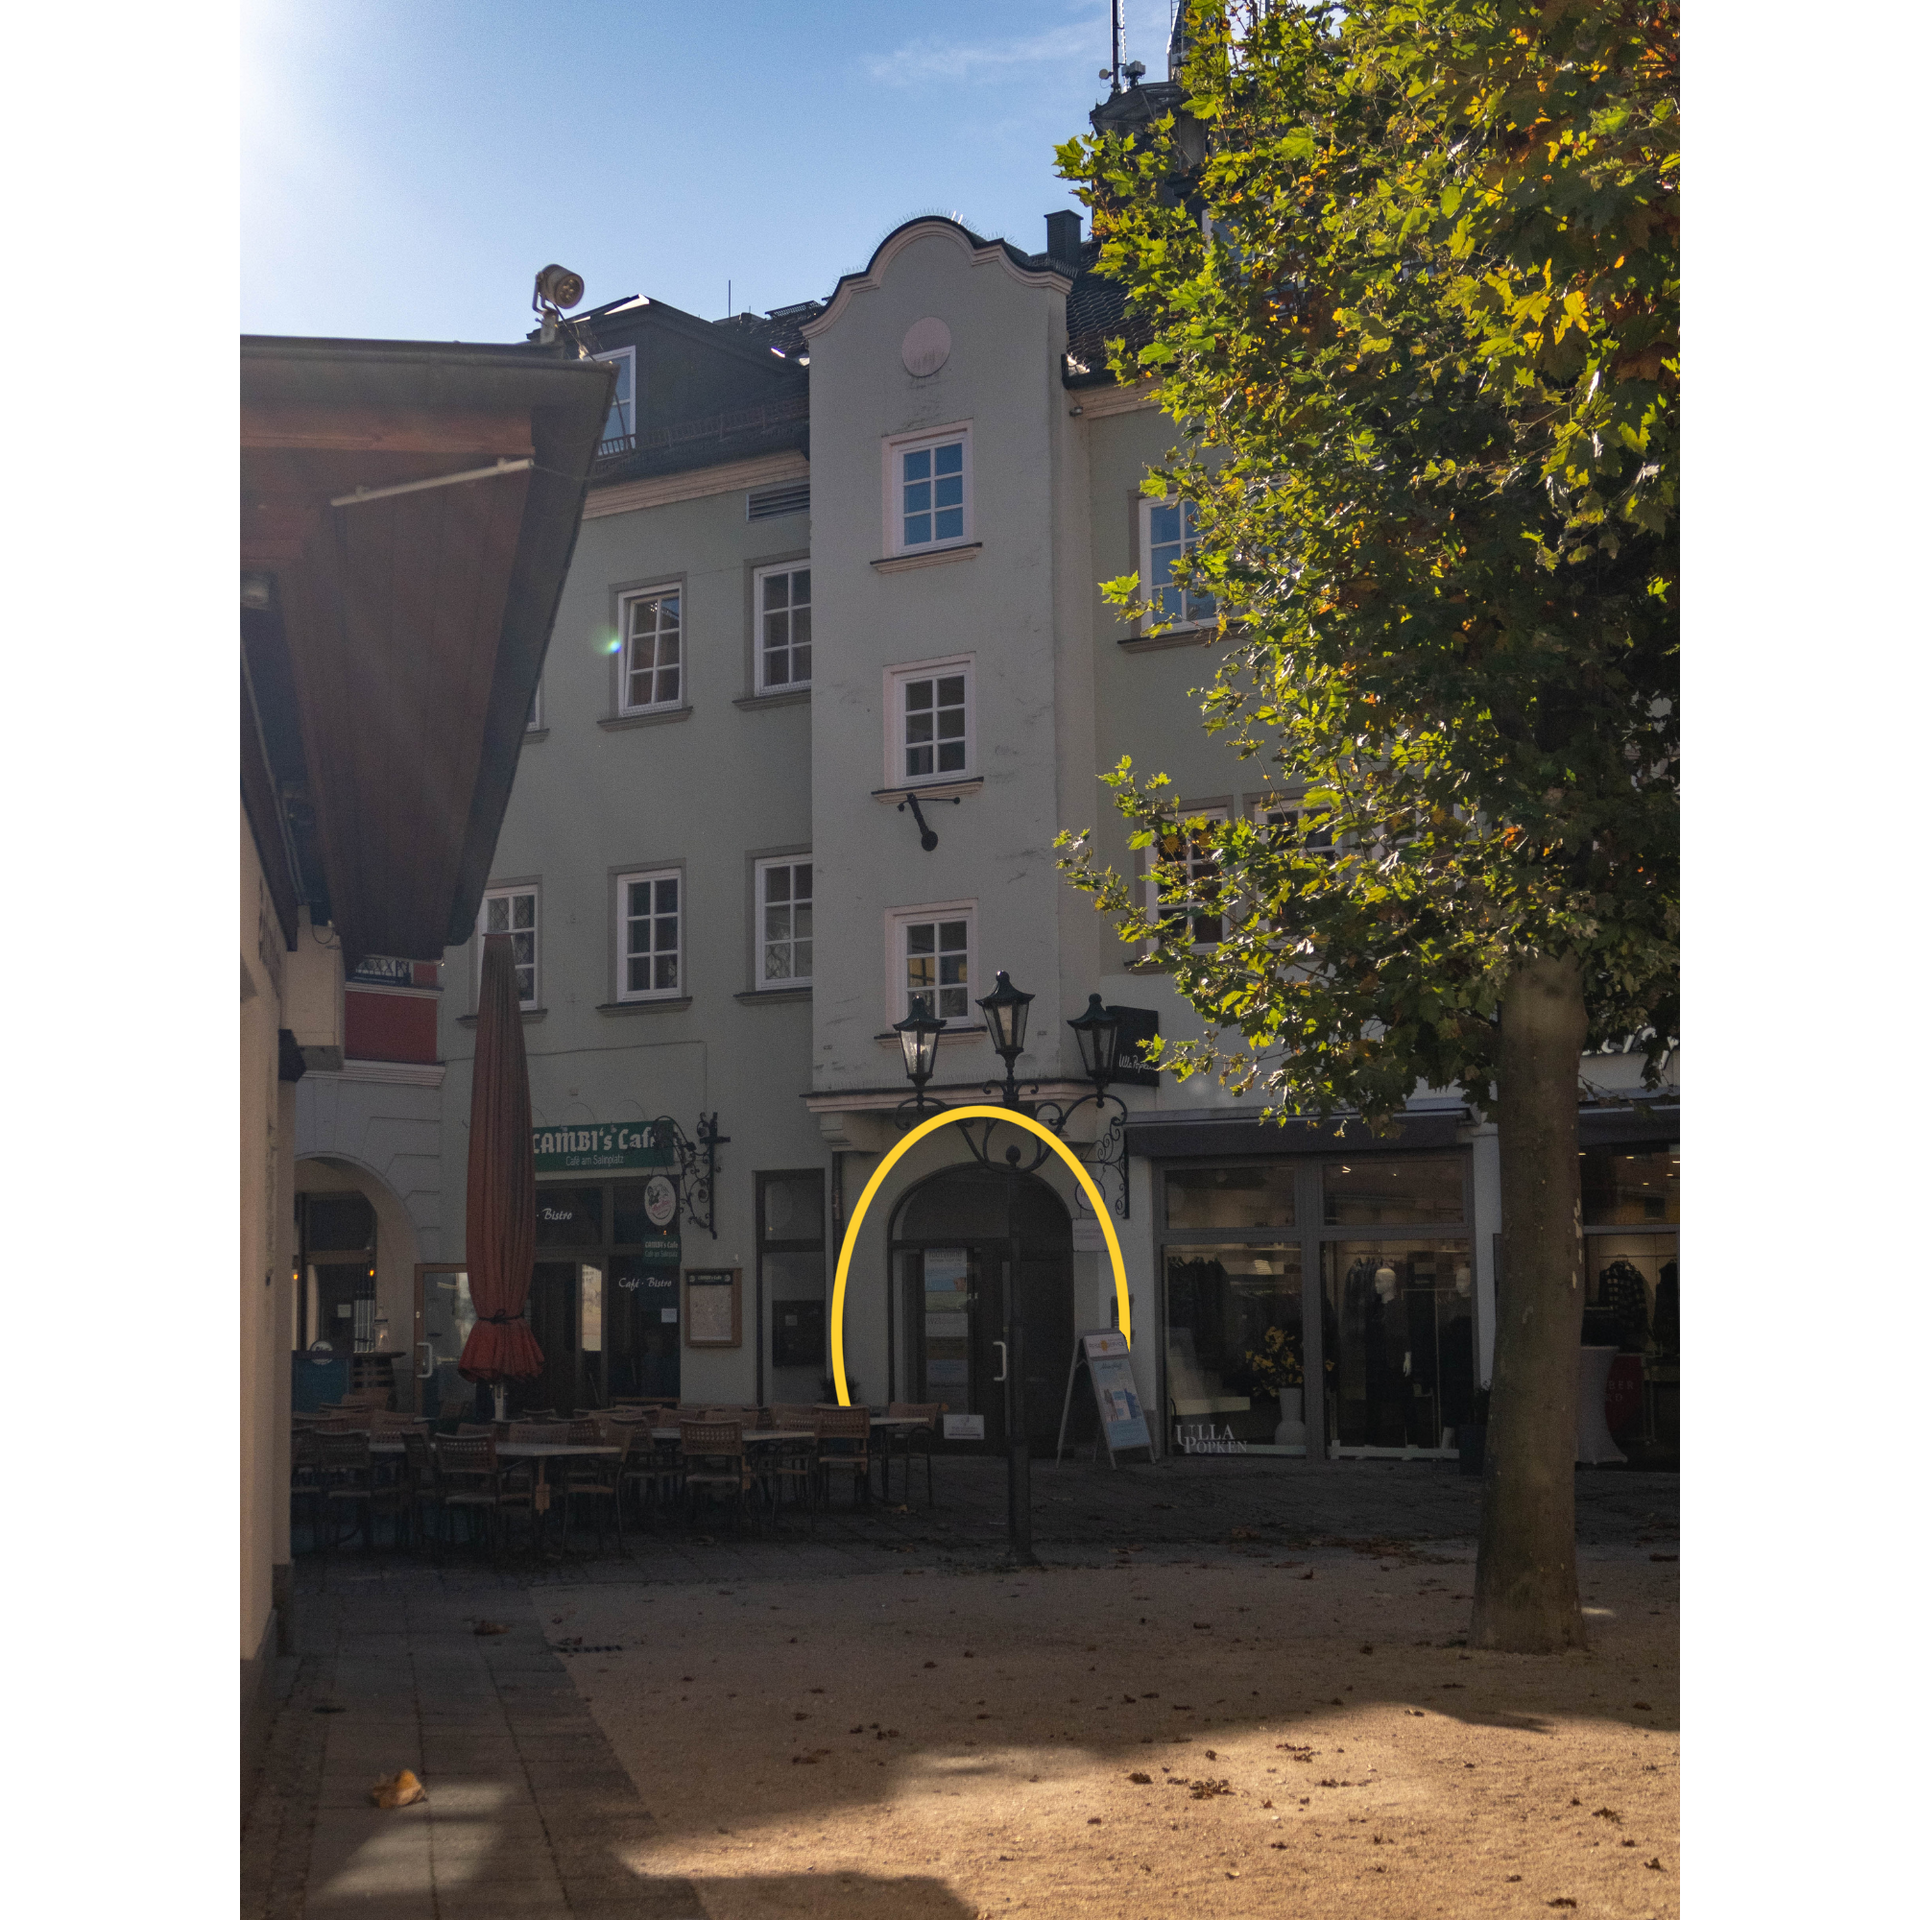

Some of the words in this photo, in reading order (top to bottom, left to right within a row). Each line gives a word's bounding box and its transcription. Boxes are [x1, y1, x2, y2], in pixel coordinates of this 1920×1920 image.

[1118, 1053, 1132, 1068] Ulla
[582, 1157, 592, 1165] am
[541, 1207, 573, 1221] Bistro
[618, 1276, 640, 1291] Café
[646, 1276, 672, 1288] Bistro
[1175, 1423, 1236, 1447] ULLA
